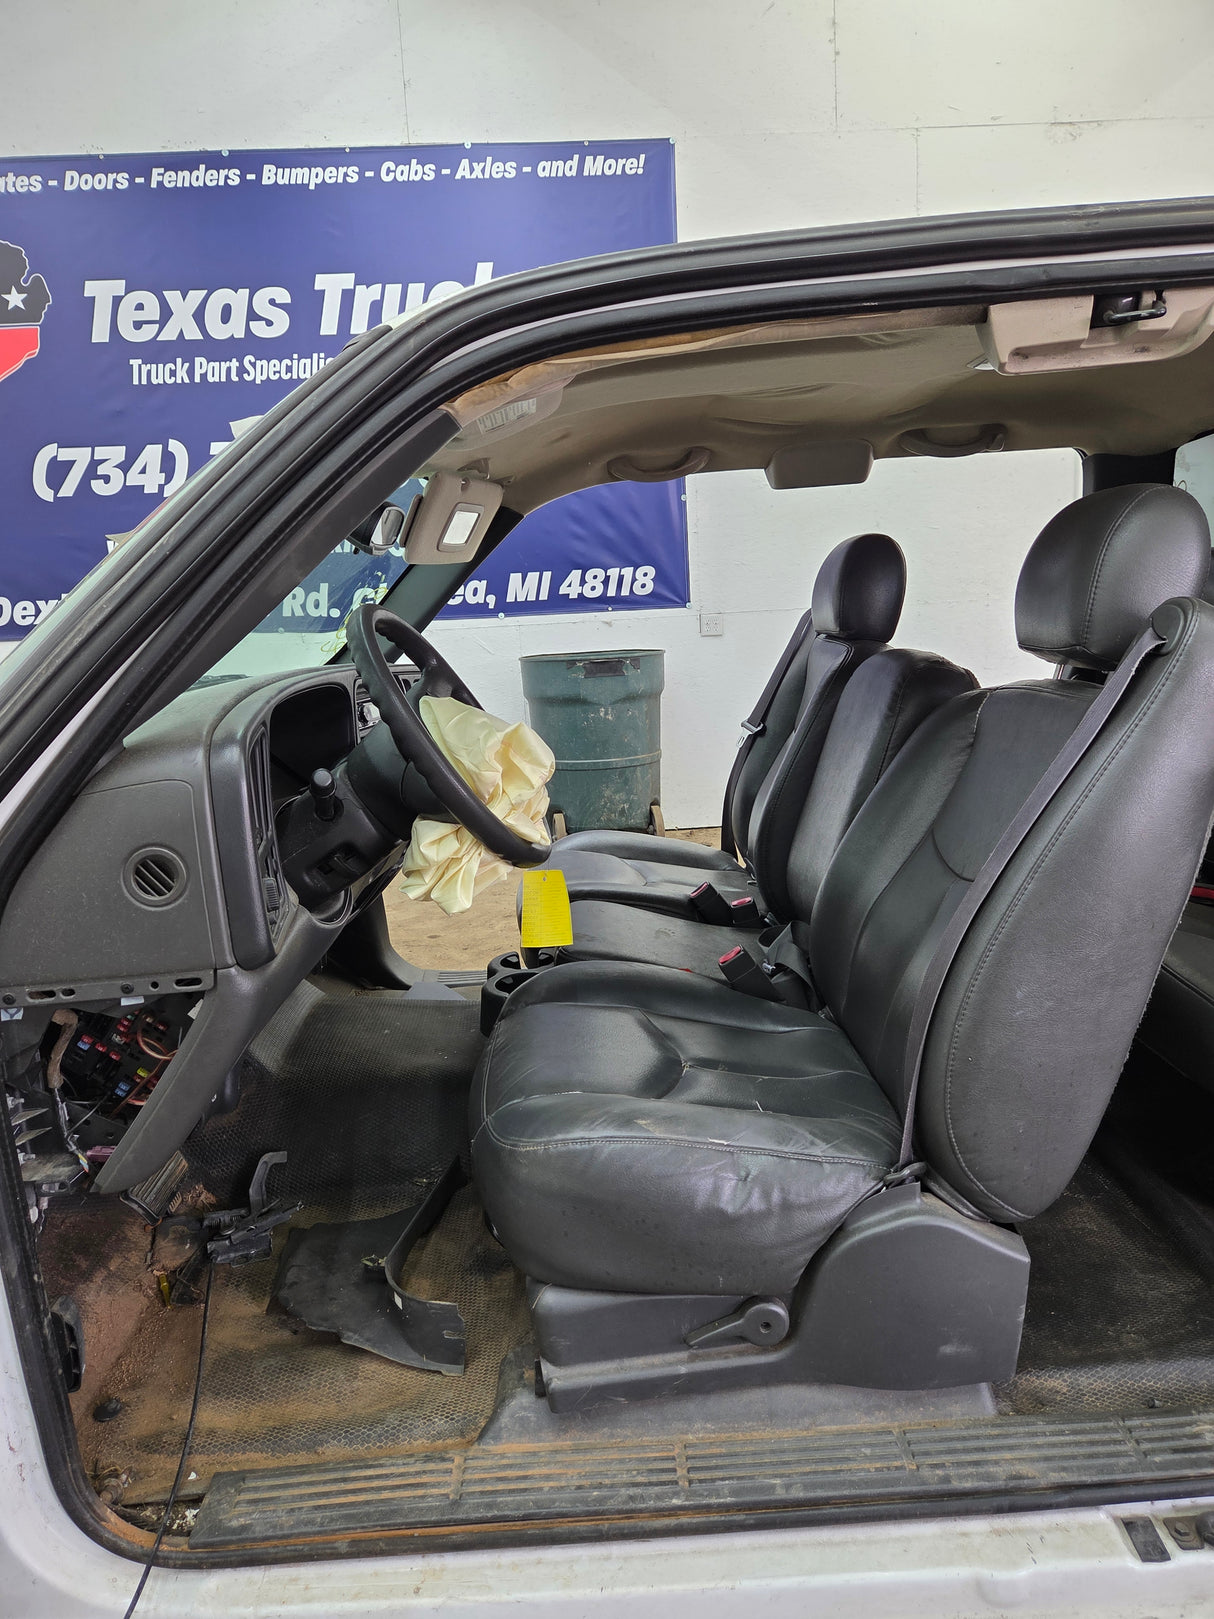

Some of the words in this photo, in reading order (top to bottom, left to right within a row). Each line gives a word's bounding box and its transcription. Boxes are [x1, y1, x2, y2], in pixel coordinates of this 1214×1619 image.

[63, 170, 130, 191] Doors
[150, 164, 241, 189] Fenders
[261, 164, 360, 190] Bumpers
[380, 158, 437, 183] Cabs
[454, 156, 517, 180] Axles
[536, 154, 580, 178] and
[582, 153, 646, 177] More!
[83, 279, 292, 343] Texas
[129, 357, 190, 385] Truck
[194, 356, 240, 383] Part
[242, 352, 335, 385] Speciali
[32, 438, 190, 503] (734)
[281, 582, 341, 618] Rd.
[506, 570, 552, 603] MI
[558, 565, 656, 599] 48118
